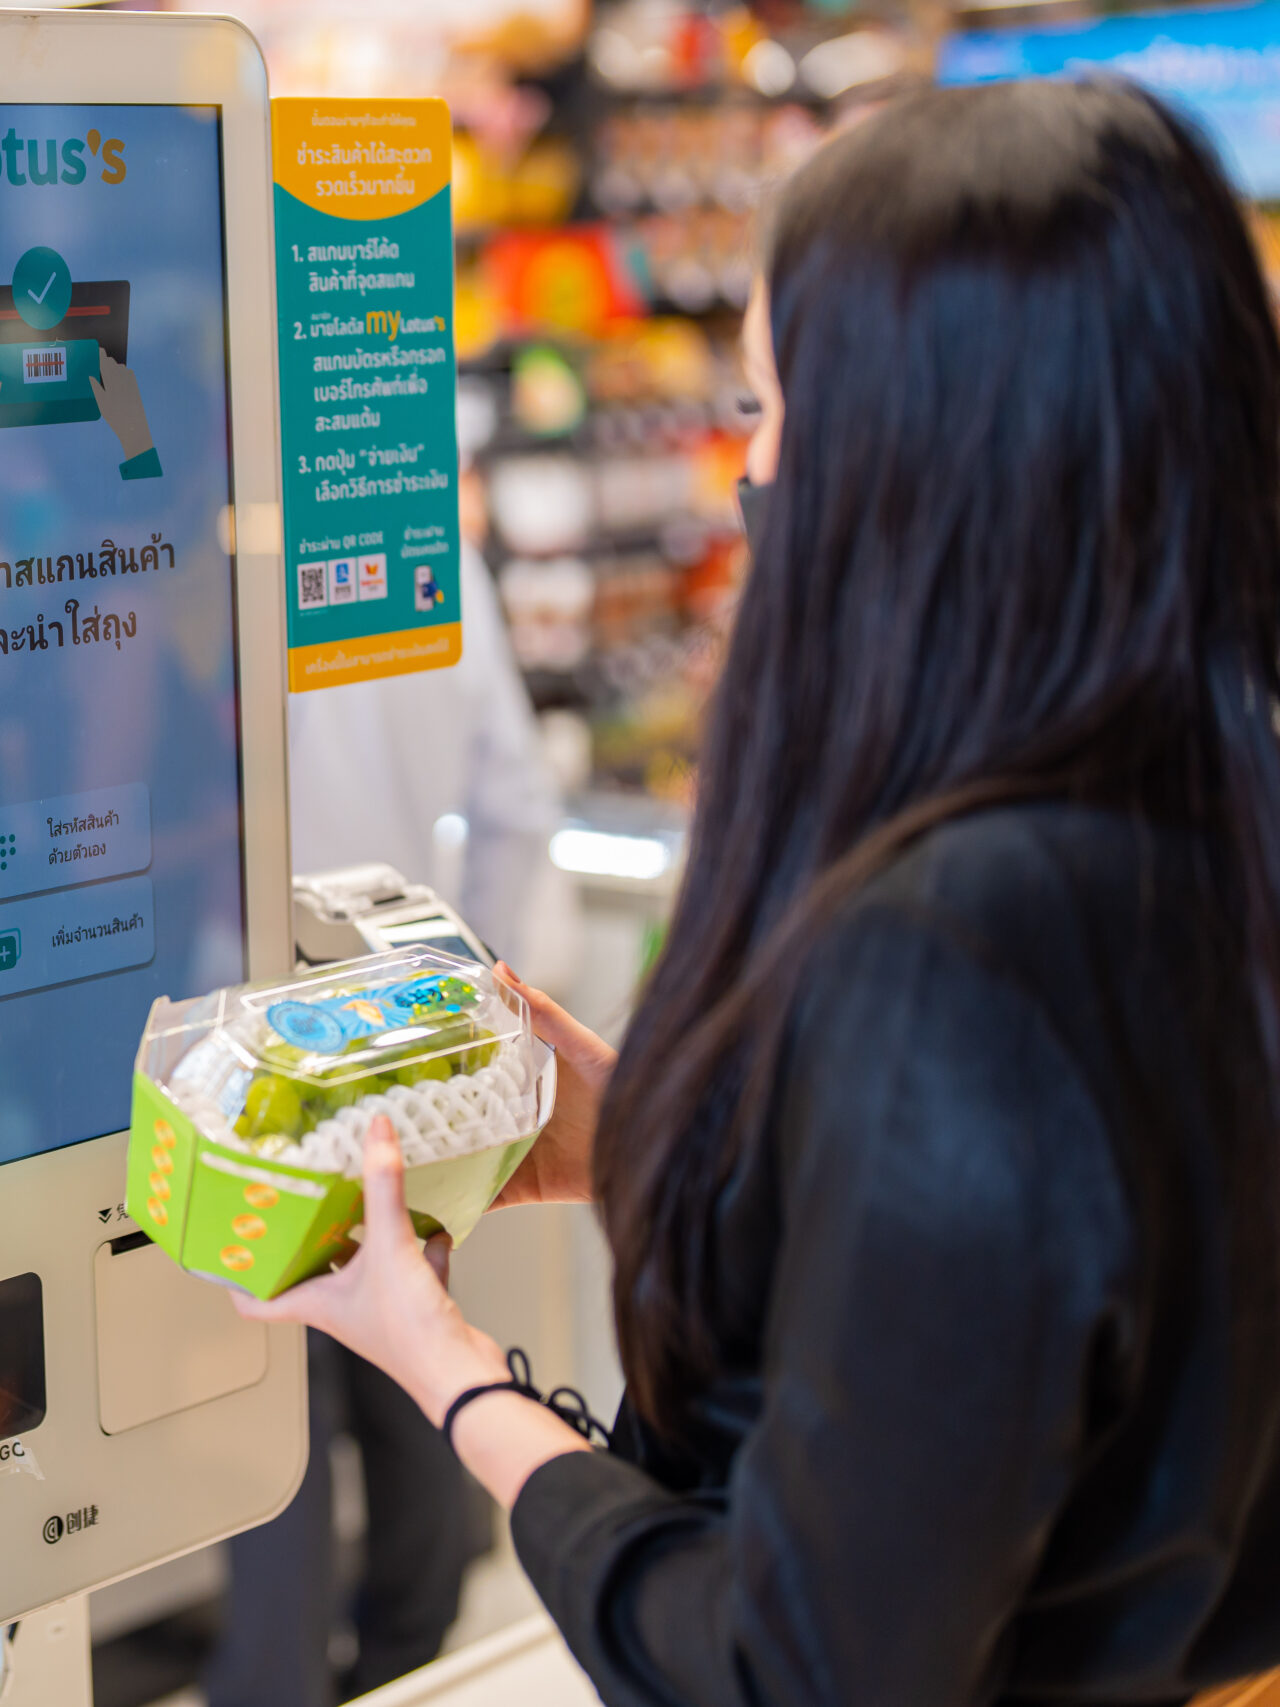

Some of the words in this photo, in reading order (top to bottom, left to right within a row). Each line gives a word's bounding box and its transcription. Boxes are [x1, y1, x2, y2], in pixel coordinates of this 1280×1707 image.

[297, 141, 432, 165] ชำระสินค้าได้สะดวก
[291, 244, 304, 262] 1.
[309, 262, 415, 296] สินค้าที่จุดสแกน
[293, 321, 307, 340] 2.
[298, 455, 312, 474] 3.
[343, 534, 356, 549] QR
[358, 531, 384, 547] CODE
[46, 810, 120, 838] ใส่รหัสสินค้า
[48, 842, 107, 866] ด้วยตัวเอง
[51, 912, 144, 948] เพิ่มจำนวนสินค้า
